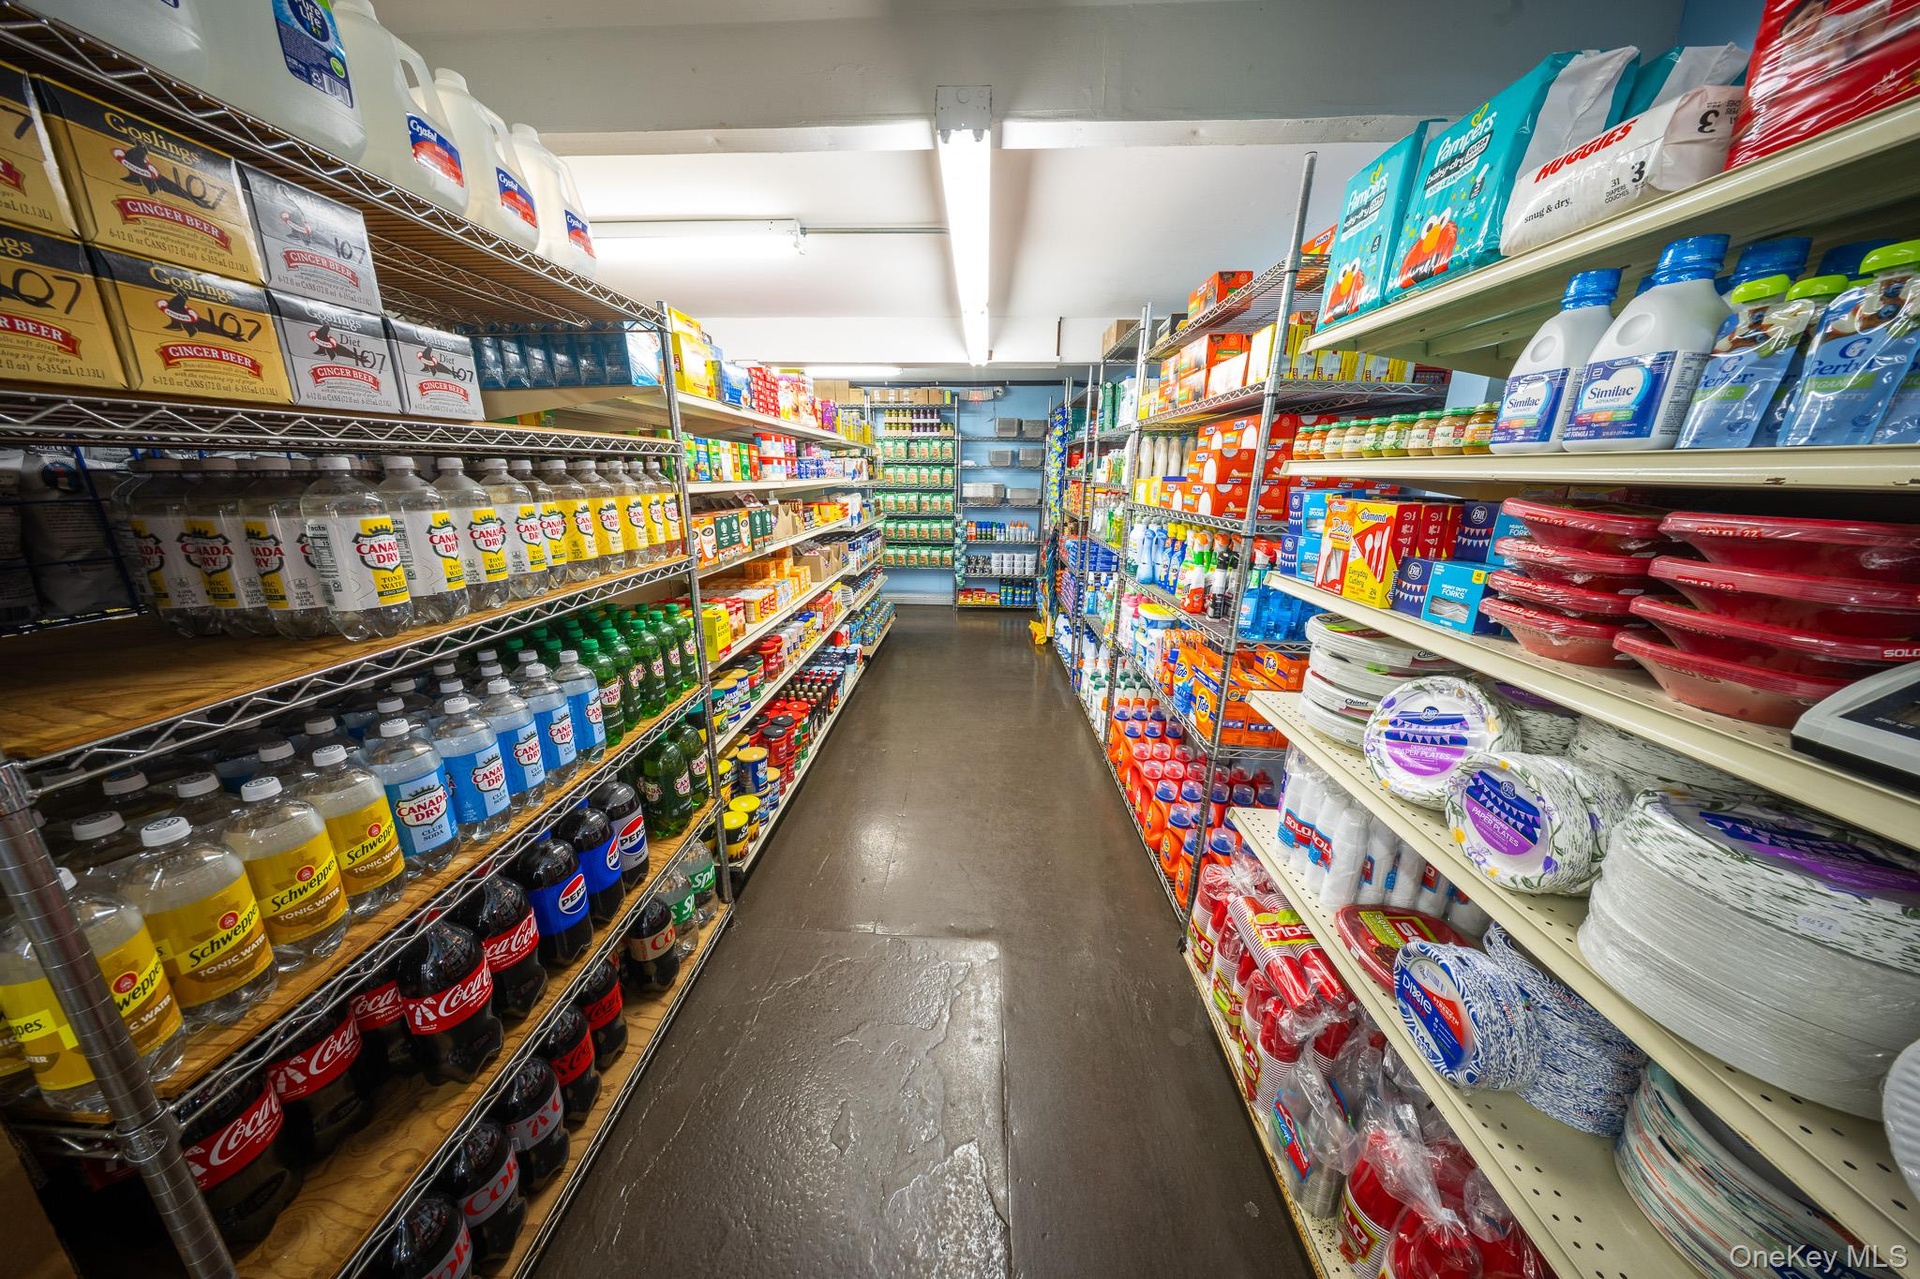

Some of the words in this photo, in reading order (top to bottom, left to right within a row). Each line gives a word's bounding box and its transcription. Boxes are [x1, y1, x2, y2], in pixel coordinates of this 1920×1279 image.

[300, 5, 321, 28] Life
[301, 0, 321, 19] ure
[104, 112, 199, 164] Goslings
[409, 119, 437, 143] Crystal
[1434, 111, 1497, 168] Pampers
[1534, 119, 1640, 184] HUGGIES
[1631, 160, 1646, 183] 3
[172, 167, 227, 211] 107
[498, 173, 518, 192] Crystal
[1606, 184, 1627, 198] DIAPERS
[1611, 178, 1620, 187] 31
[1605, 190, 1629, 205] COUCHES
[126, 201, 184, 223] GINGER
[186, 215, 220, 238] BEER
[1524, 208, 1545, 224] snug
[1545, 204, 1554, 214] &
[144, 237, 166, 251] CANS
[290, 251, 329, 268] GINGER
[329, 261, 353, 279] BEER
[150, 267, 236, 303] Goslings
[207, 308, 262, 342] 107
[305, 304, 362, 331] Goslings
[13, 319, 63, 342] BEER
[339, 333, 362, 348] Diet
[168, 347, 220, 360] GINGER
[222, 351, 252, 367] BEER
[439, 353, 455, 365] Diet
[36, 364, 74, 376] 6-355mL
[76, 367, 105, 380] (2.13L)
[317, 366, 351, 379] GINGER
[353, 371, 375, 385] BEER
[184, 380, 204, 389] CANS
[422, 382, 448, 392] GINGER
[448, 385, 466, 396] BEER
[1588, 384, 1635, 400] Similac
[1507, 397, 1541, 409] Similac
[1361, 512, 1386, 522] diamond
[376, 554, 399, 564] DRY
[1348, 566, 1368, 579] Everyday
[1349, 576, 1365, 588] Cutlery
[1442, 589, 1465, 599] FORKS
[1174, 662, 1188, 678] Tide
[1265, 656, 1276, 670] Tide
[1197, 695, 1210, 713] Tide
[1345, 698, 1369, 706] Chinet
[1420, 750, 1451, 760] PLATES
[396, 790, 448, 817] CANADA
[415, 804, 442, 823] DRY
[1486, 812, 1509, 831] DESIGNER
[421, 824, 443, 837] CLUB
[423, 829, 444, 842] SODA
[1285, 816, 1311, 837] SOLO
[1472, 806, 1493, 827] PAPER
[1493, 823, 1519, 847] PLATES
[353, 858, 381, 874] TONIC
[382, 845, 400, 862] WATER
[279, 904, 314, 921] TONIC
[315, 886, 340, 907] WATER
[198, 954, 239, 977] TONIC
[240, 933, 266, 957] WATER
[141, 996, 172, 1023] WATER
